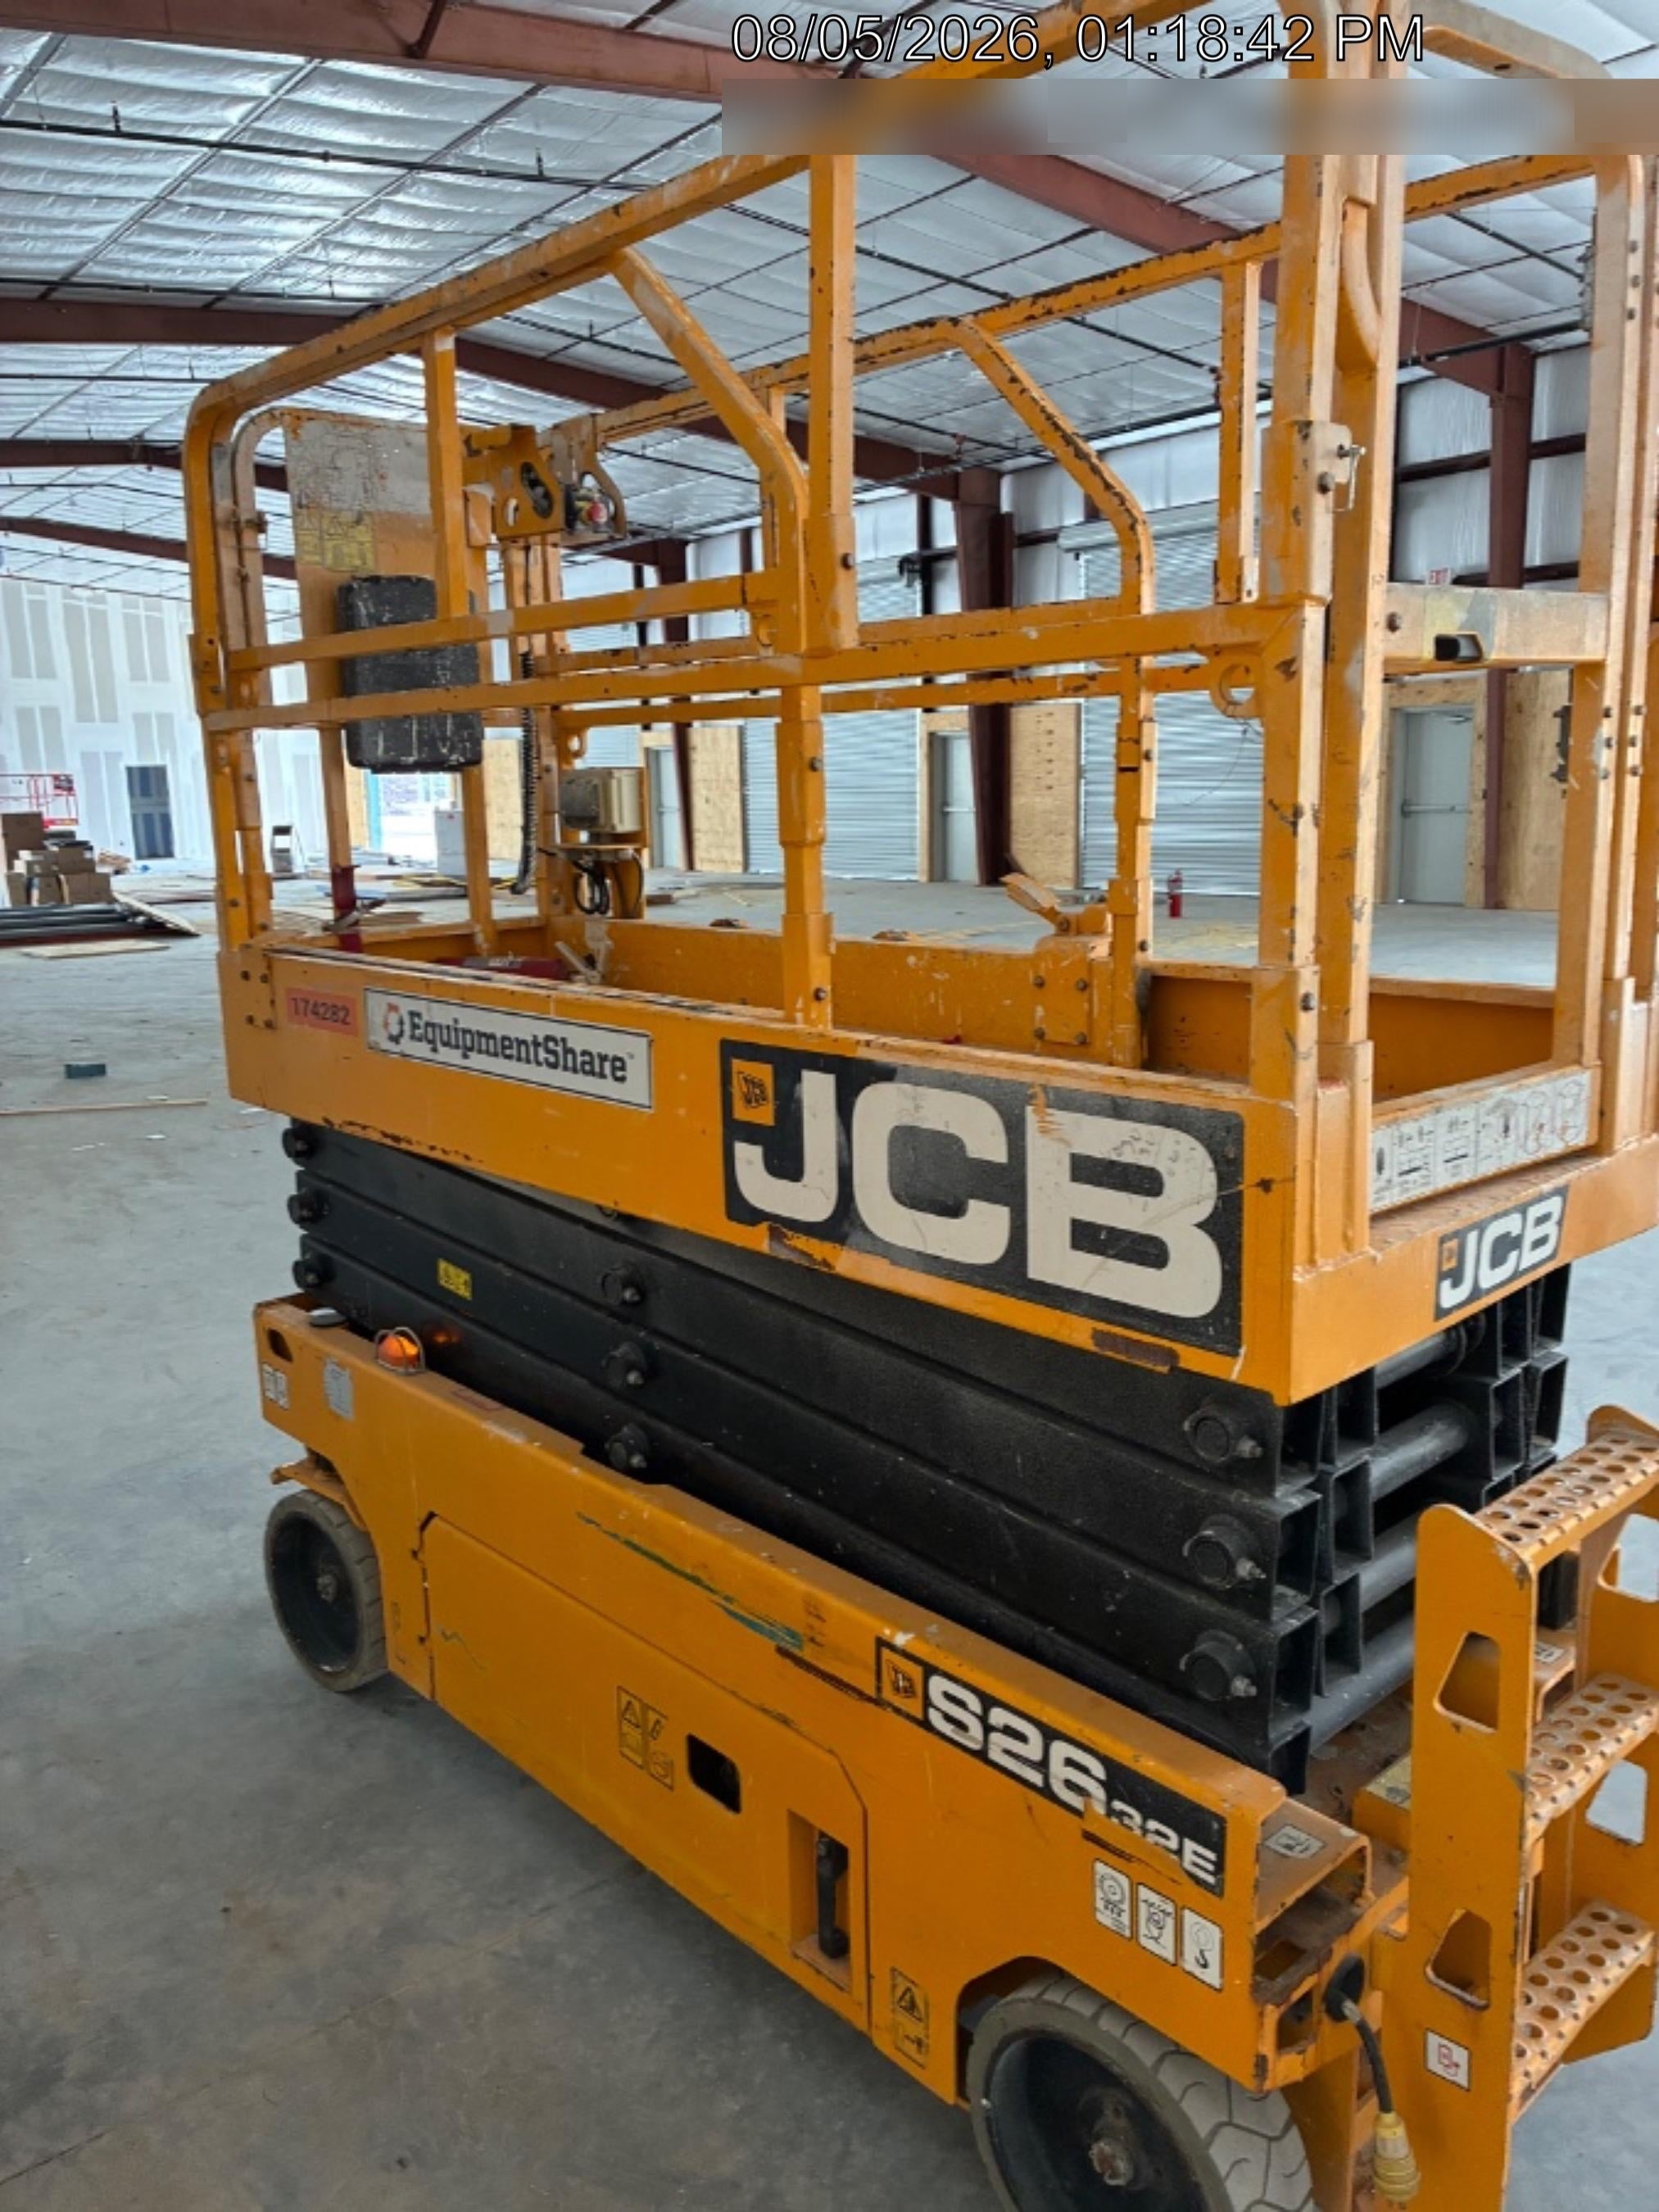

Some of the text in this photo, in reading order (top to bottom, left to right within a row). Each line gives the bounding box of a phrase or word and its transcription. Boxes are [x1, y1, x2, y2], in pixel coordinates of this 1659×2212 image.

[291, 996, 352, 1026] 174282
[409, 1010, 628, 1083] EquipmentShare
[734, 1068, 1223, 1319] JCB
[1439, 1196, 1563, 1309] JCB
